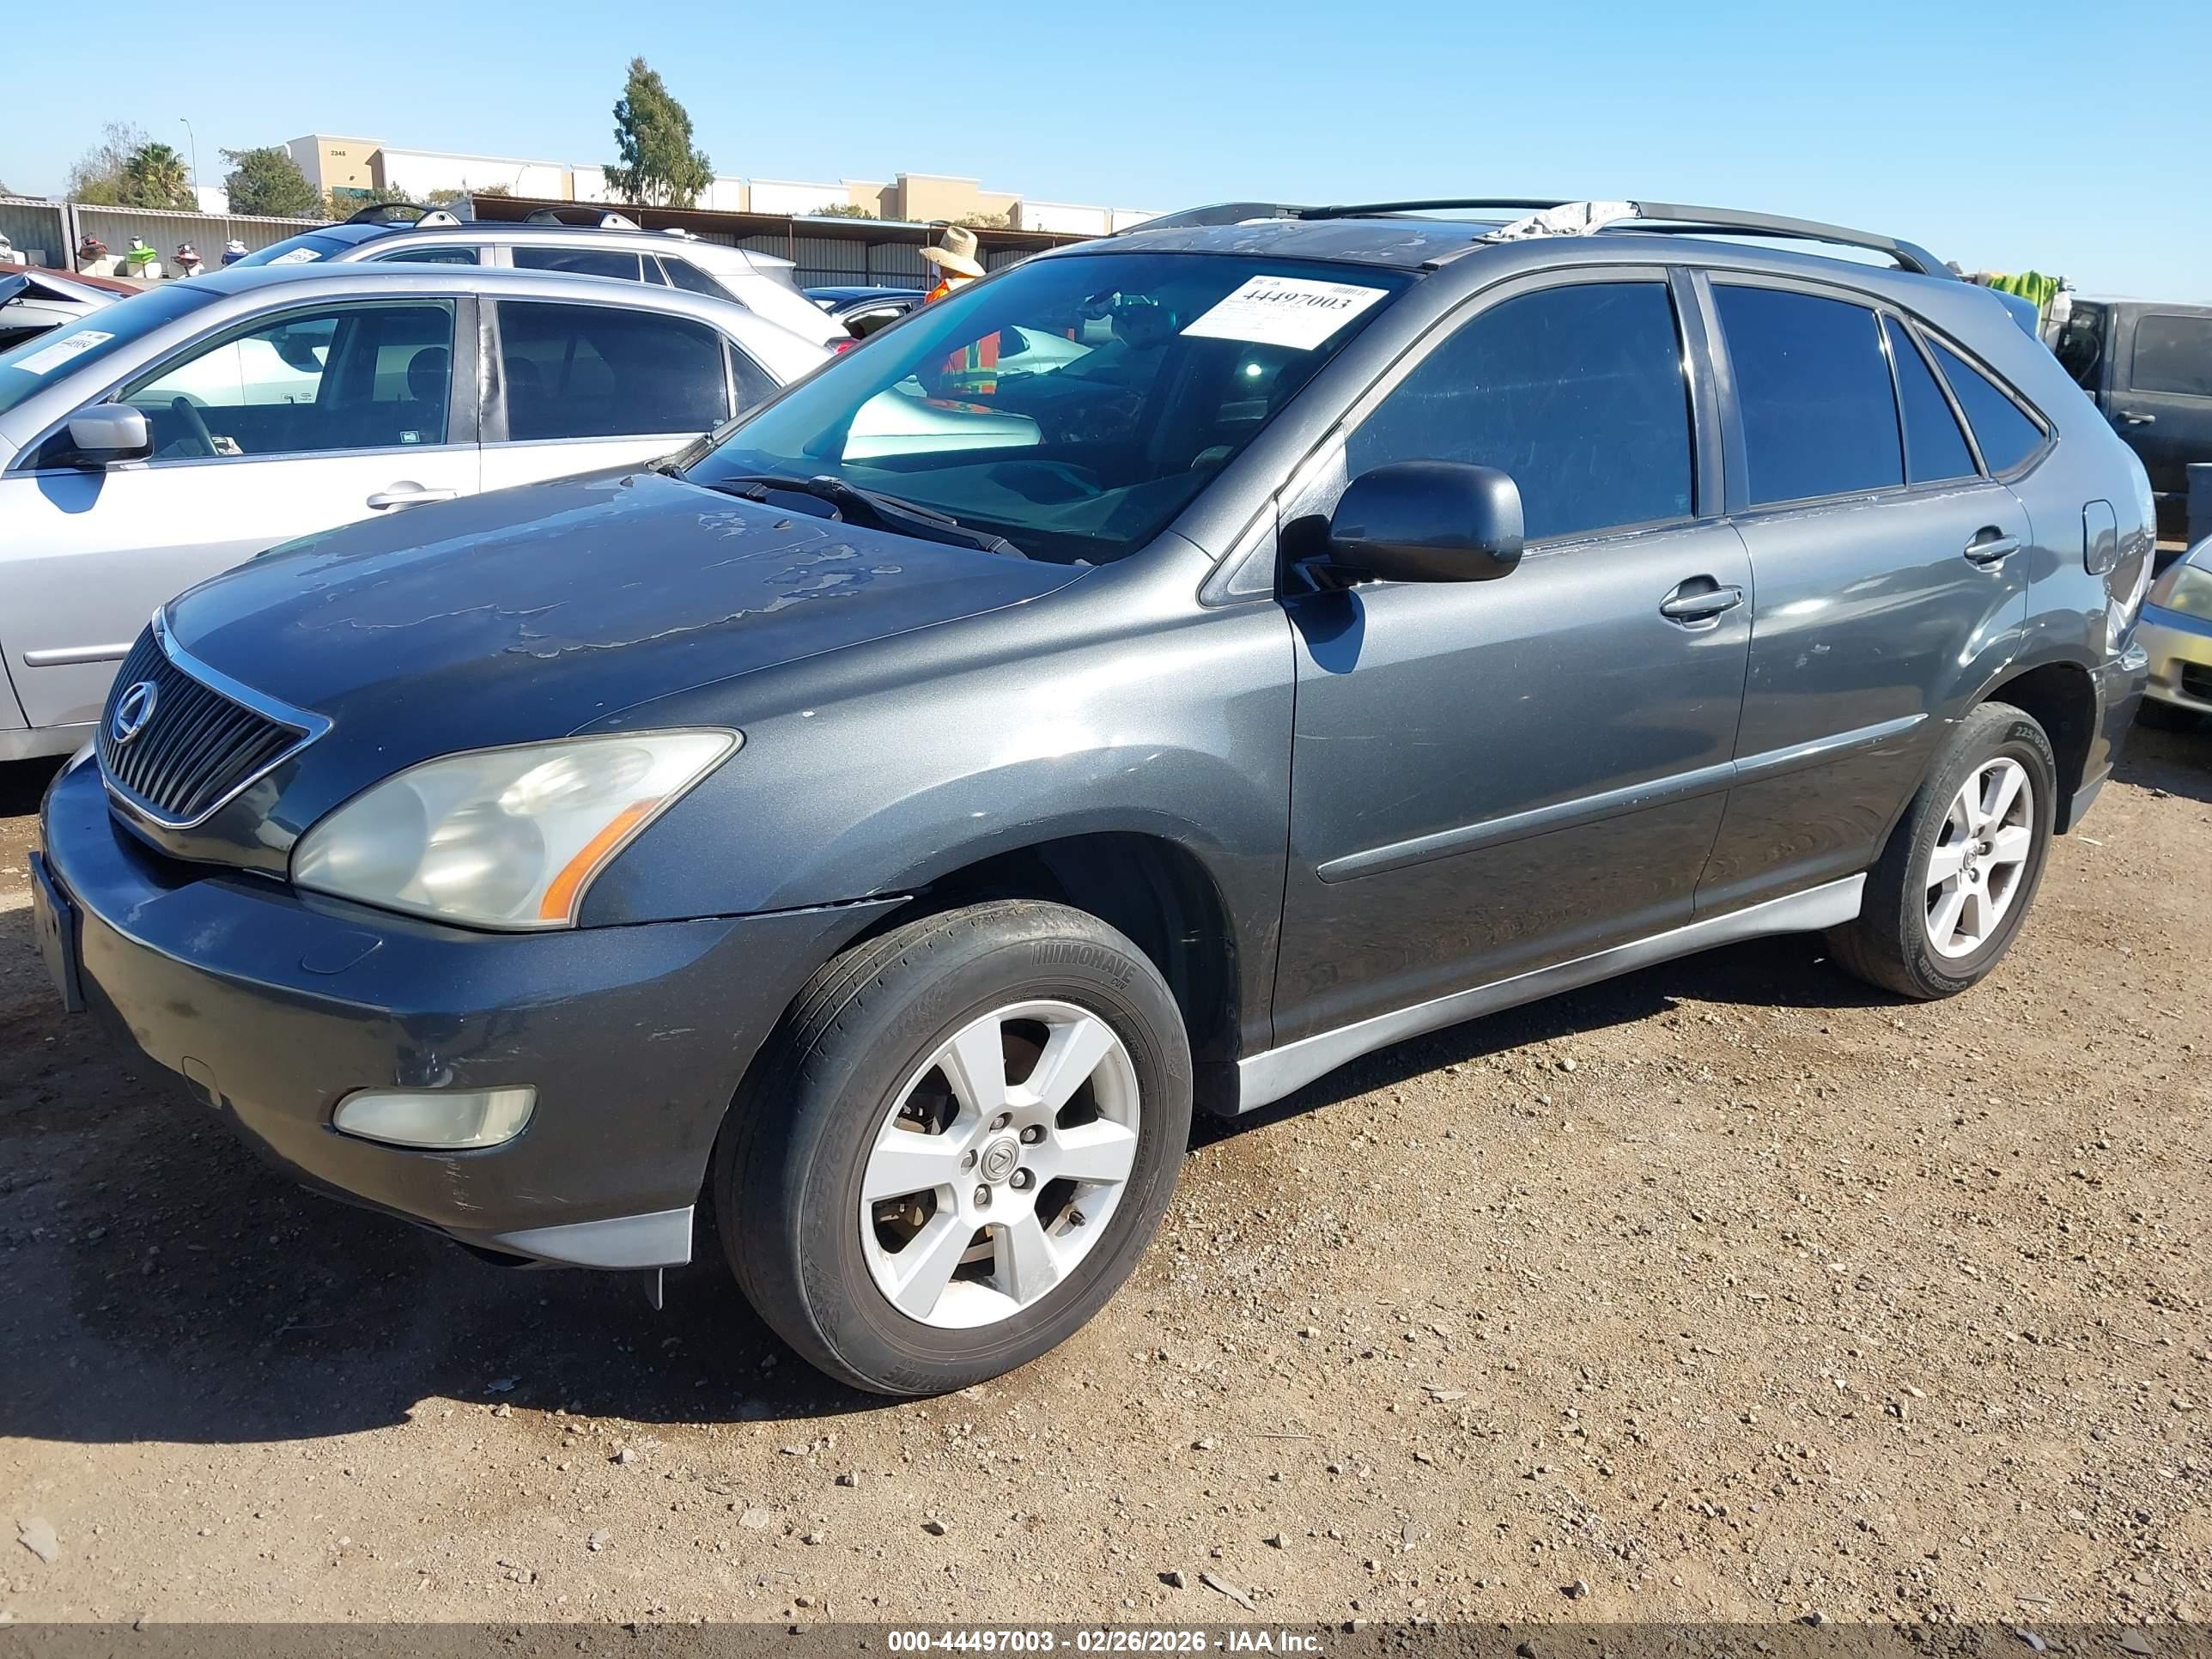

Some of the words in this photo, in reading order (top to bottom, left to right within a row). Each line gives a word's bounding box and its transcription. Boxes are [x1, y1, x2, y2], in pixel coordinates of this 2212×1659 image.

[1242, 289, 1352, 310] 44497003
[1058, 944, 1137, 984] MOHAVE
[1917, 954, 1968, 992] CROSSOVER
